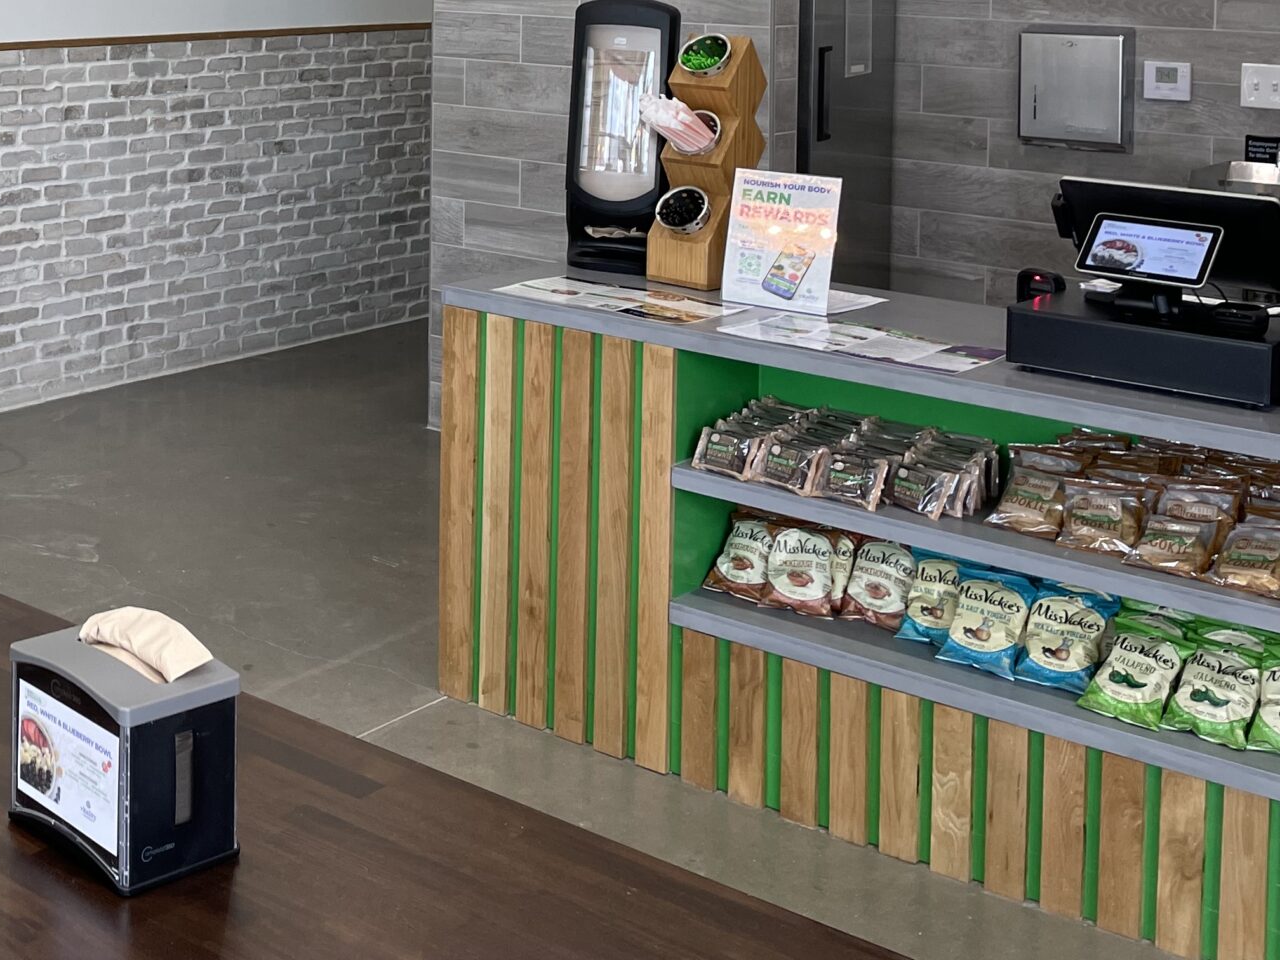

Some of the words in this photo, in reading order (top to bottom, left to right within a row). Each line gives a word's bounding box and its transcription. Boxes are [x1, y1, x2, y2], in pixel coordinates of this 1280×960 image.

[744, 179, 781, 189] NOURISH
[808, 186, 832, 194] BODY
[742, 188, 791, 206] EARN
[740, 204, 828, 226] REWARDS
[1046, 625, 1059, 635] SALT
[1066, 630, 1092, 640] VINEGAR
[1114, 656, 1156, 675] JALAPEÑO
[1194, 672, 1236, 691] JALAPEÑO
[40, 708, 57, 725] WHITE
[62, 722, 94, 747] BLUEBERRY
[95, 742, 112, 759] BOWL
